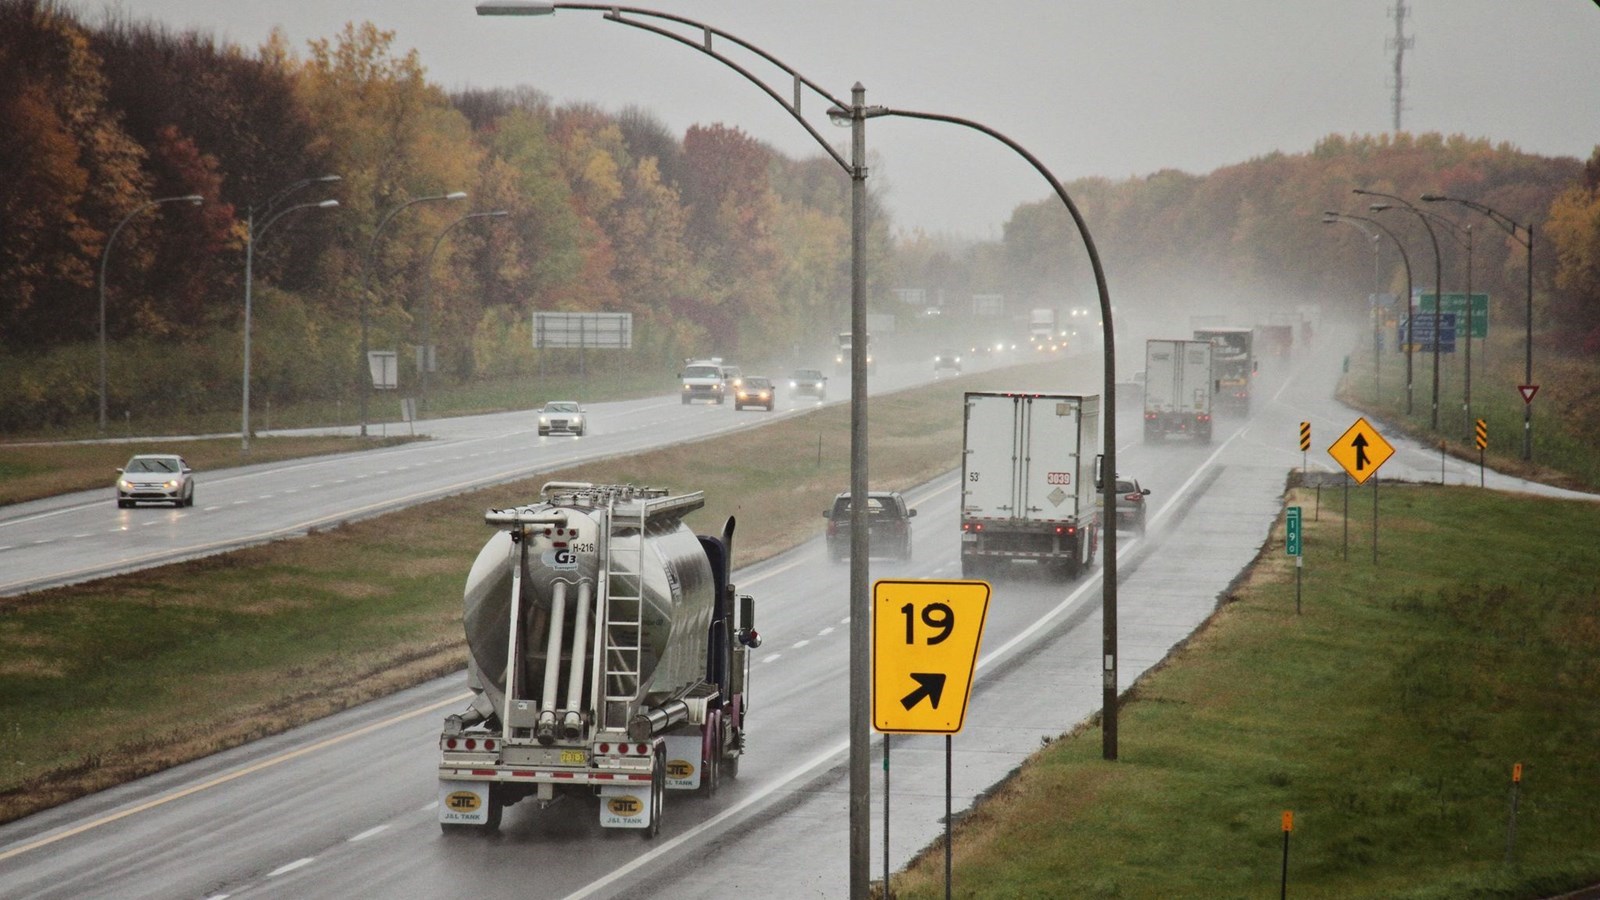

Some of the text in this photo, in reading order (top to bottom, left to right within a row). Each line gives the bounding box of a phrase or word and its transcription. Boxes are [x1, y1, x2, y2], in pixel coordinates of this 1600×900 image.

[1048, 473, 1070, 484] 3039
[573, 543, 594, 552] H-216
[555, 549, 576, 563] G3
[901, 602, 955, 646] 19
